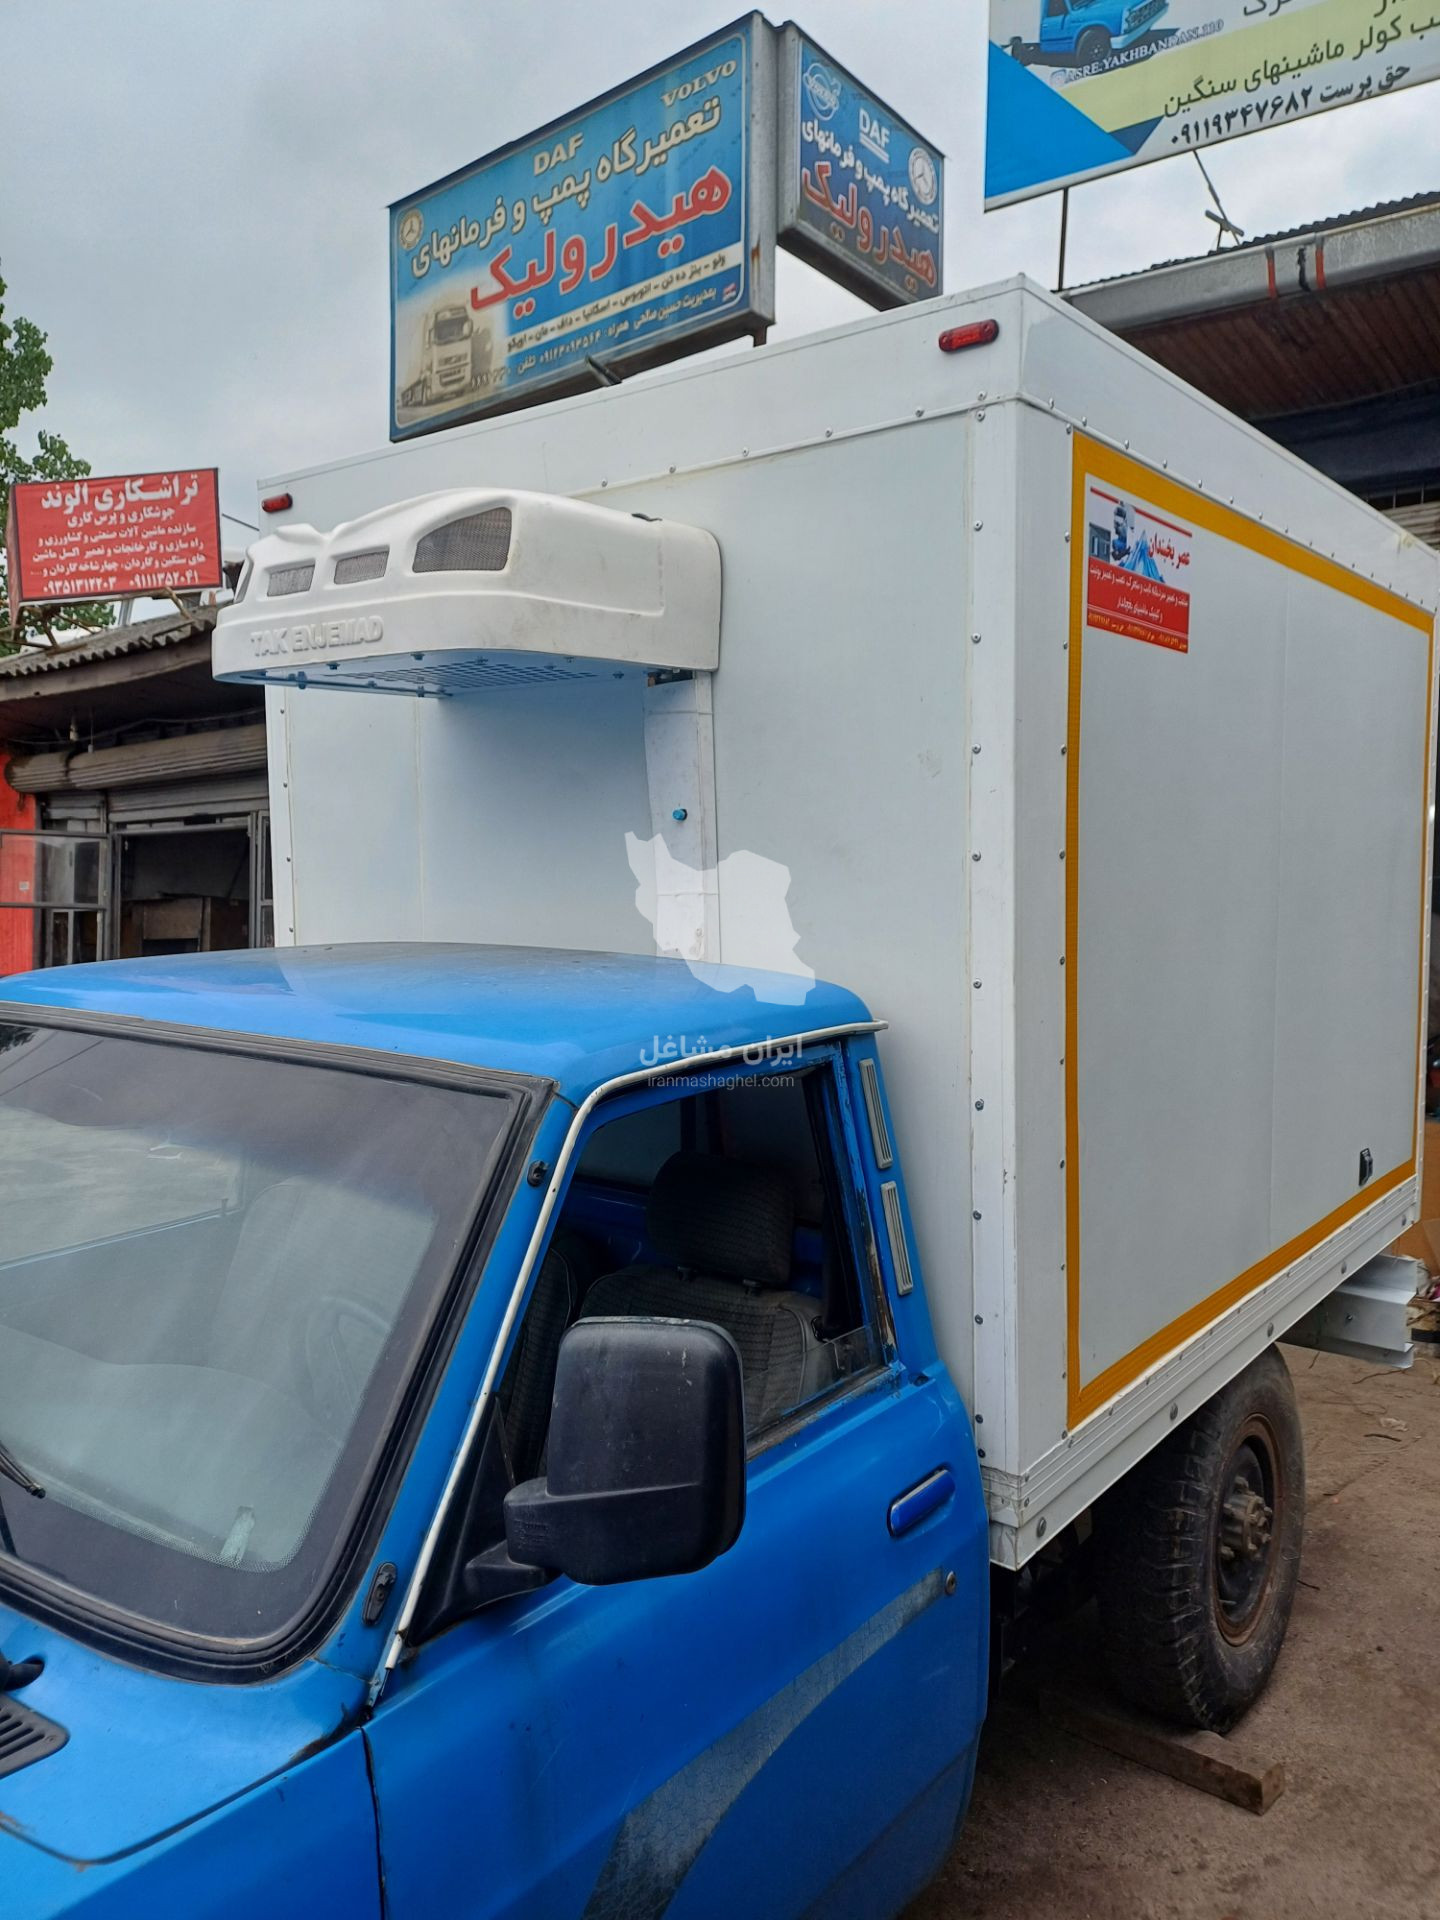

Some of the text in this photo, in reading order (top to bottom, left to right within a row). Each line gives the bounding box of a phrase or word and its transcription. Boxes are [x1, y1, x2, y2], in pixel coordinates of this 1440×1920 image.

[1353, 15, 1402, 61] کولر
[660, 60, 737, 107] VOLVO
[1243, 40, 1345, 92] ماشینهای
[1378, 63, 1412, 91] حق
[1164, 75, 1237, 119] سنگین
[1319, 79, 1372, 106] پرست
[859, 108, 890, 148] DAF
[533, 132, 584, 176] DAF
[411, 96, 722, 278] تعمیرگاه پمپ و فرمانهای
[802, 119, 939, 234] تعمیرگاه پمپ و فرمانهای
[470, 165, 733, 318] هیدرولیک
[802, 161, 937, 293] هیدرولیک
[41, 474, 198, 514] تراشکاری الوند
[127, 506, 175, 523] جوشکاری
[119, 525, 139, 538] آلات
[141, 526, 166, 539] ماشین
[250, 627, 288, 657] TAK
